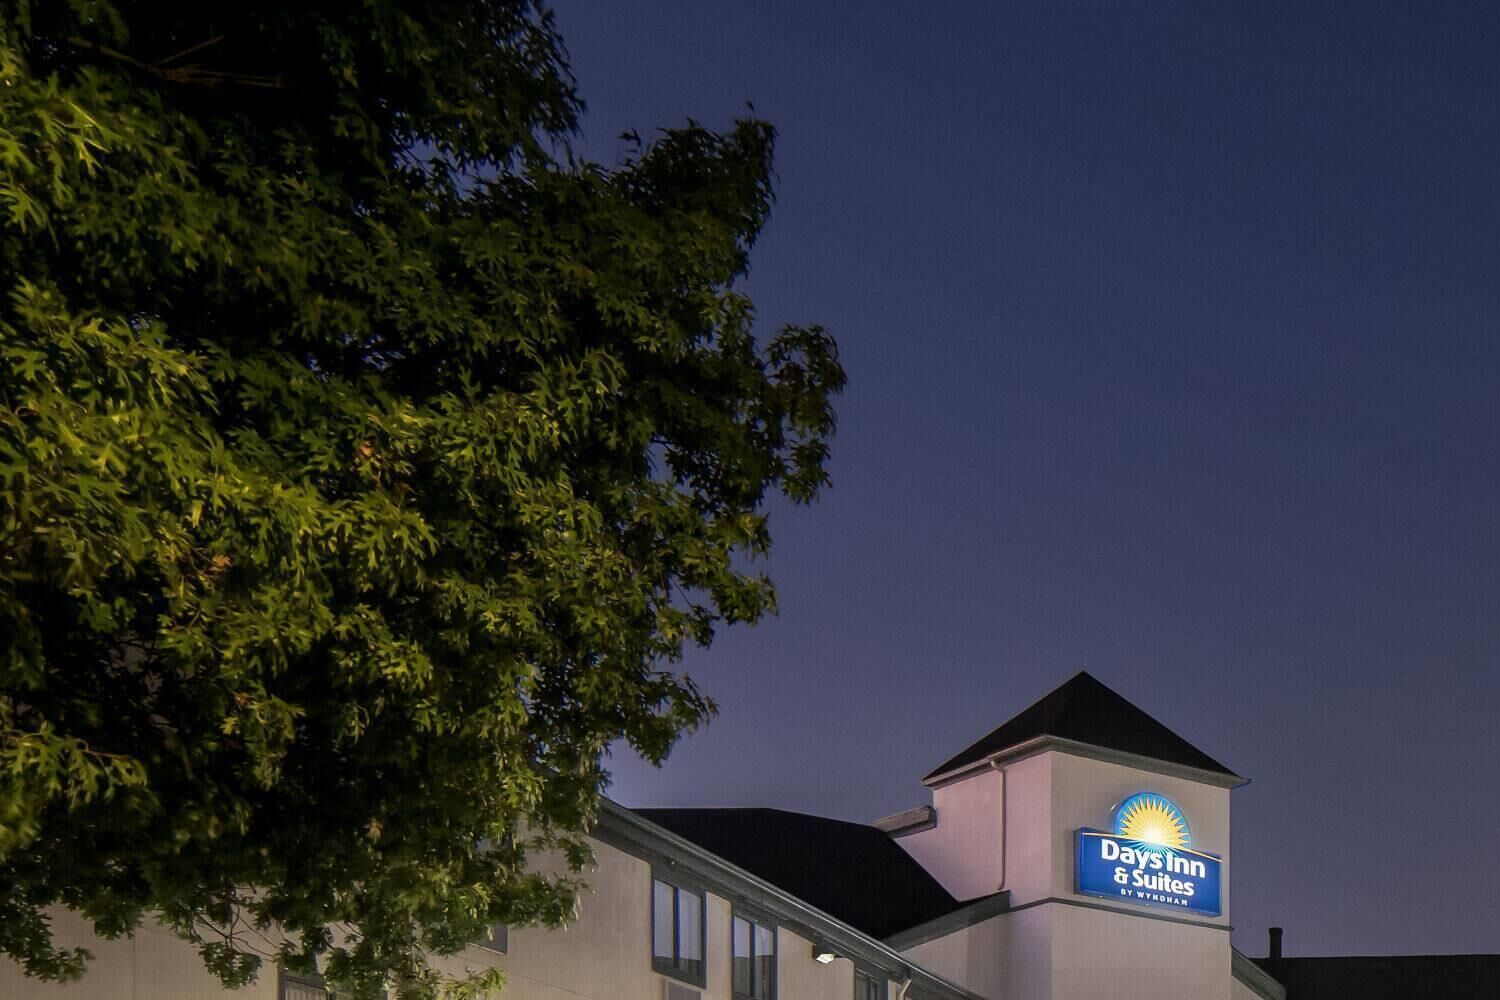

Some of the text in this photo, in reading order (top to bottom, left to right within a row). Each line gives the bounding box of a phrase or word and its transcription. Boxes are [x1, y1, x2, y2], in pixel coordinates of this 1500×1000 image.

[1101, 838, 1206, 879] Days Inn
[1113, 866, 1195, 897] & Suites
[1120, 888, 1188, 906] BY WYNDHAM
